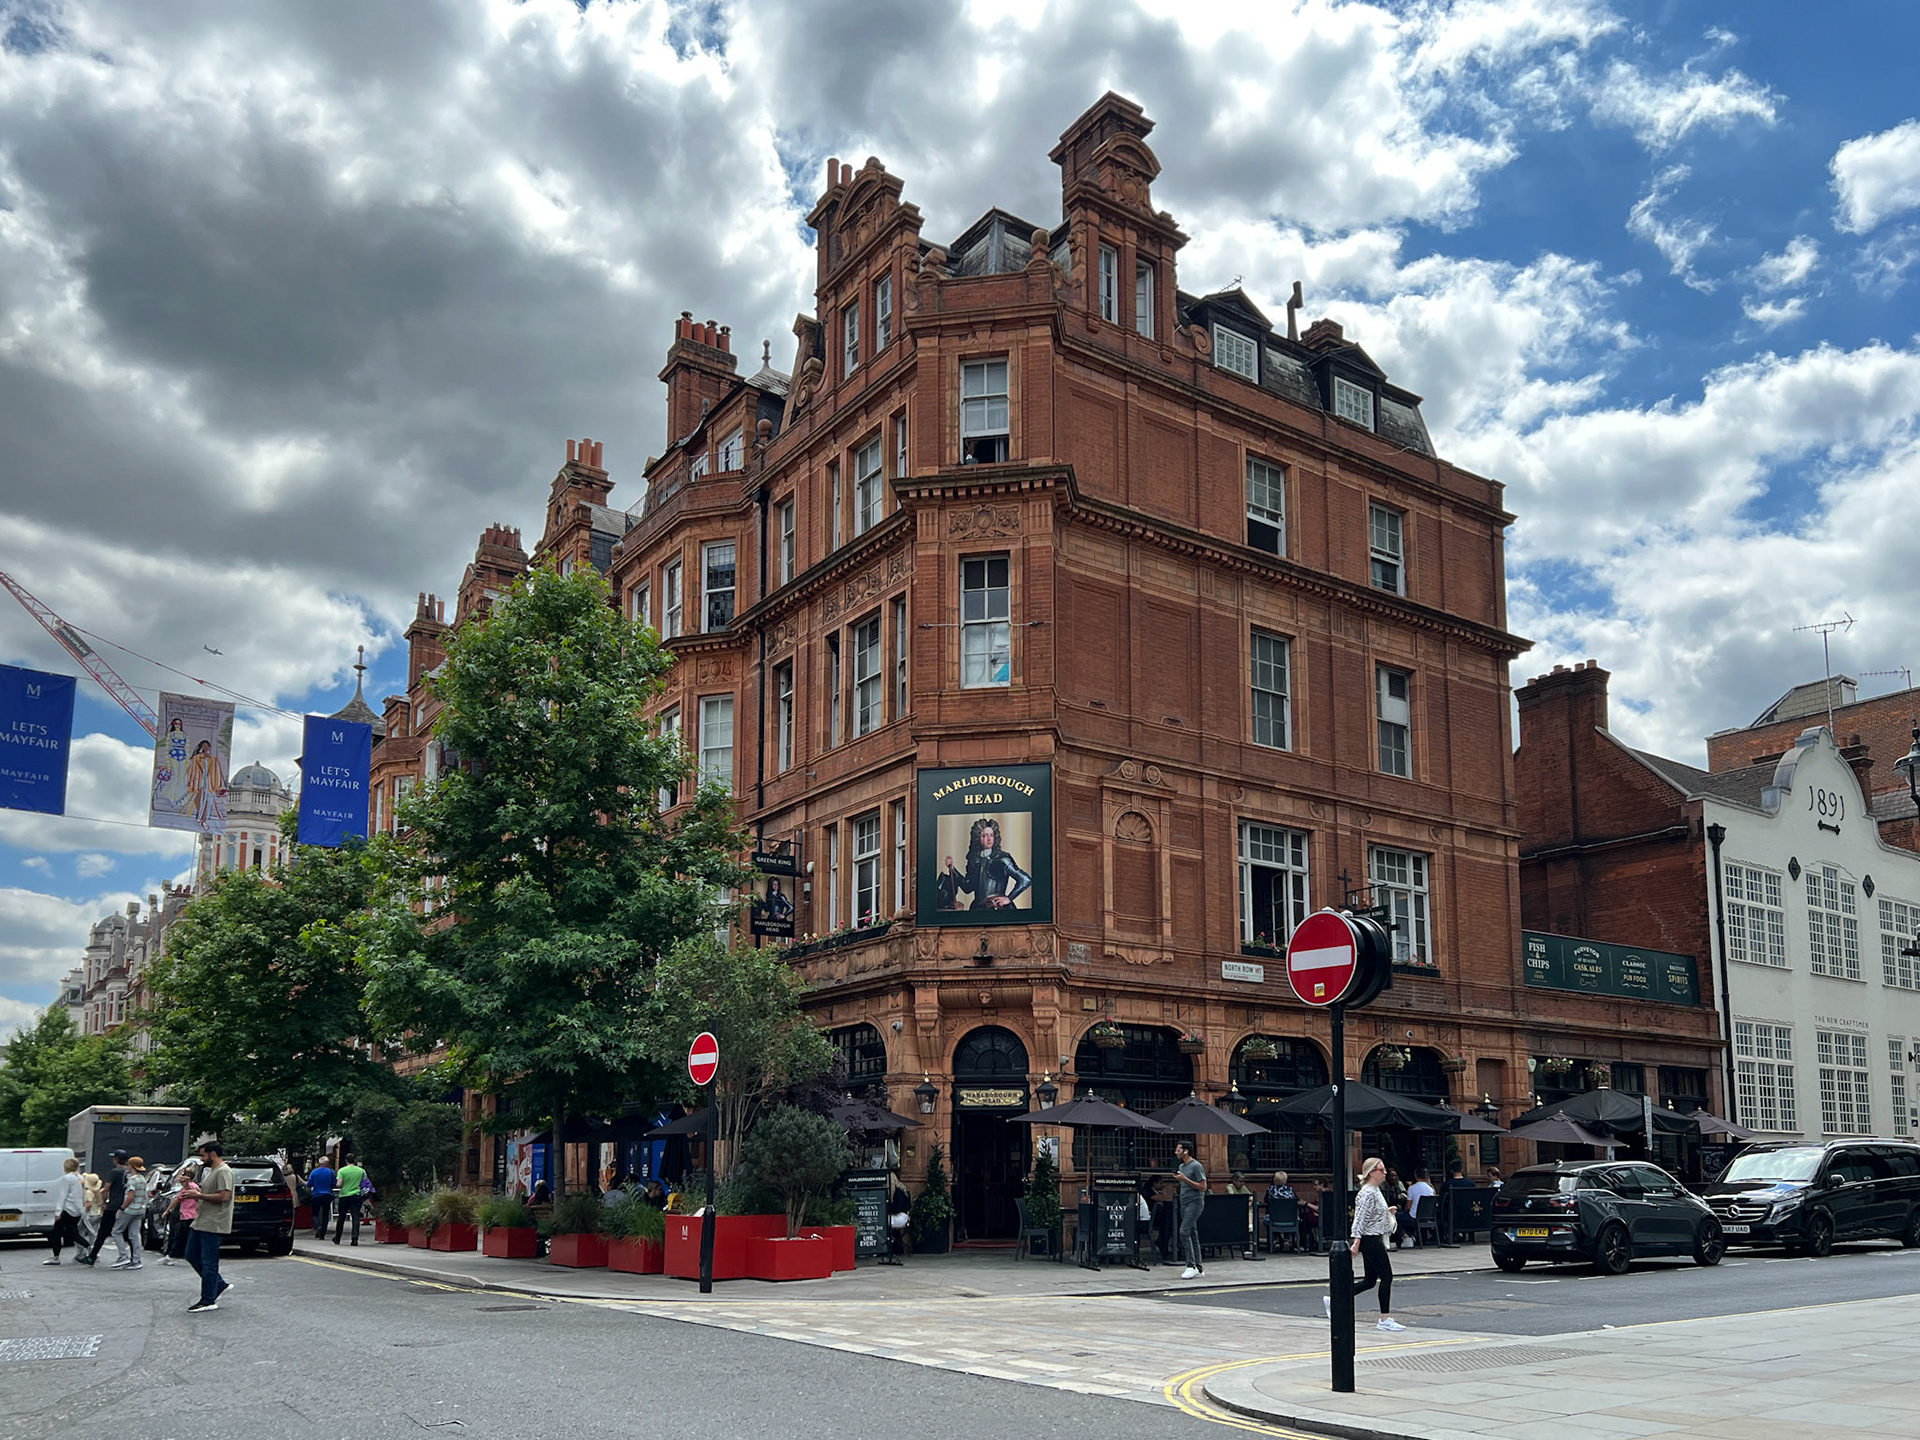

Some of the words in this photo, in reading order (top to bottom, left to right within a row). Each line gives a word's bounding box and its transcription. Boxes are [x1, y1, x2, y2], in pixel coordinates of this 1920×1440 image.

[26, 684, 41, 696] M
[12, 721, 48, 735] LET'S
[0, 732, 58, 749] MAYFAIR
[331, 731, 344, 742] M
[1, 768, 49, 781] MAYFAIR
[321, 766, 350, 777] LET'S
[310, 776, 359, 790] MAYFAIR
[932, 775, 1035, 800] MARLBOROUGH
[964, 793, 1003, 804] HEAD
[1809, 785, 1845, 821] 1891
[313, 809, 353, 819] MAYFAIR
[756, 856, 777, 864] GREENE
[755, 920, 791, 928] MARLBOROUGH
[1528, 942, 1546, 953] FISH
[1224, 963, 1241, 972] NORTH
[1526, 958, 1550, 969] CHIPS
[1573, 963, 1588, 971] CASK
[1588, 965, 1602, 973] ALES
[1668, 974, 1688, 985] SPIRITS
[1815, 1015, 1825, 1023] THE
[1839, 1018, 1869, 1028] CRAFTSMEN
[121, 1126, 144, 1134] FREE
[145, 1127, 169, 1137] delivery
[681, 1225, 688, 1236] M
